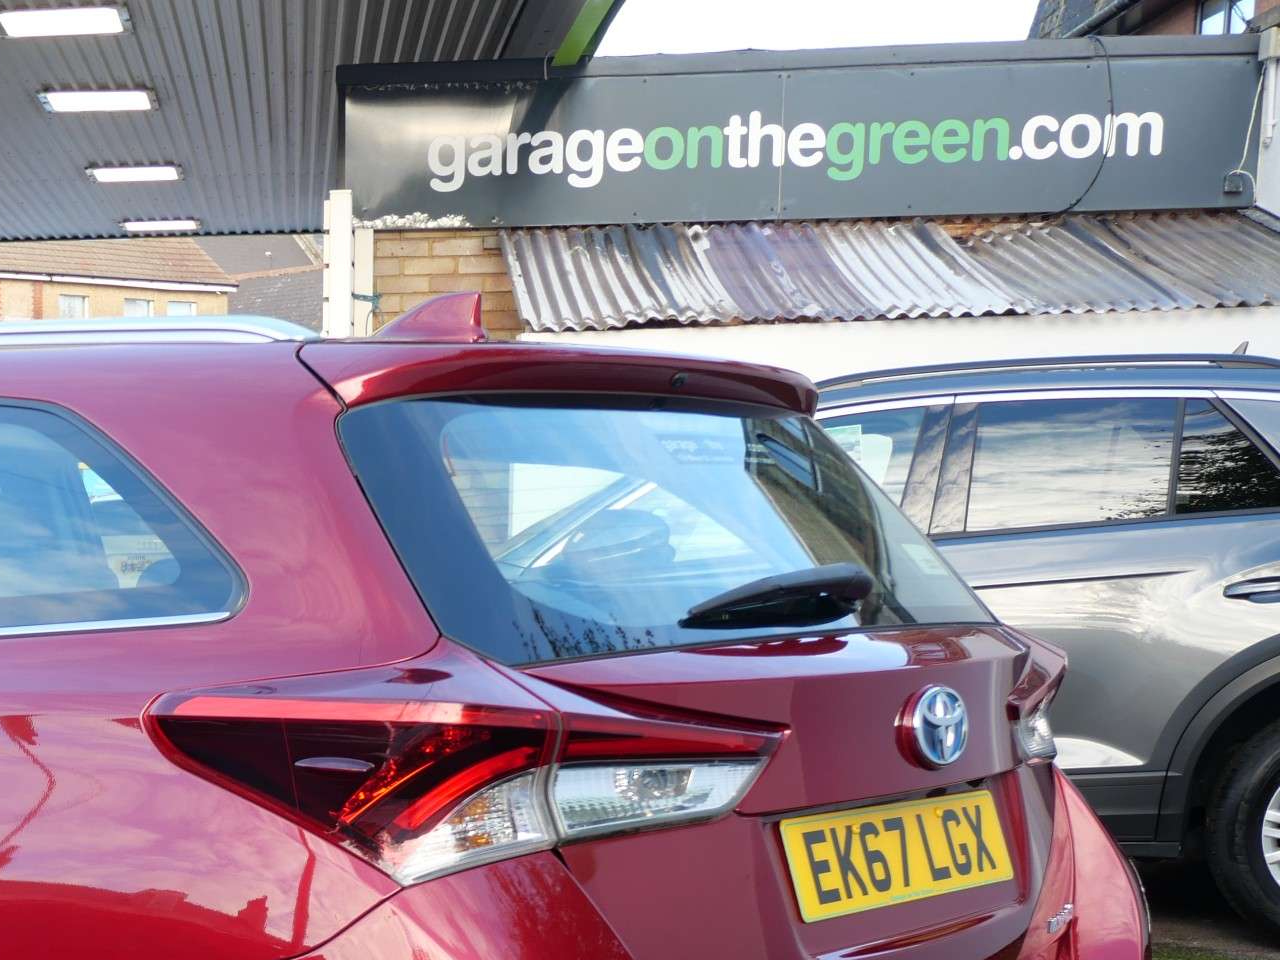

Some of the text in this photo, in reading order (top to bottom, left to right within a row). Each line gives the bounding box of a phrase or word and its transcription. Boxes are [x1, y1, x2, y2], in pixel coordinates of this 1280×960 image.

[426, 110, 1164, 193] garageonthegreen.com
[801, 804, 997, 905] EK67 LGX
